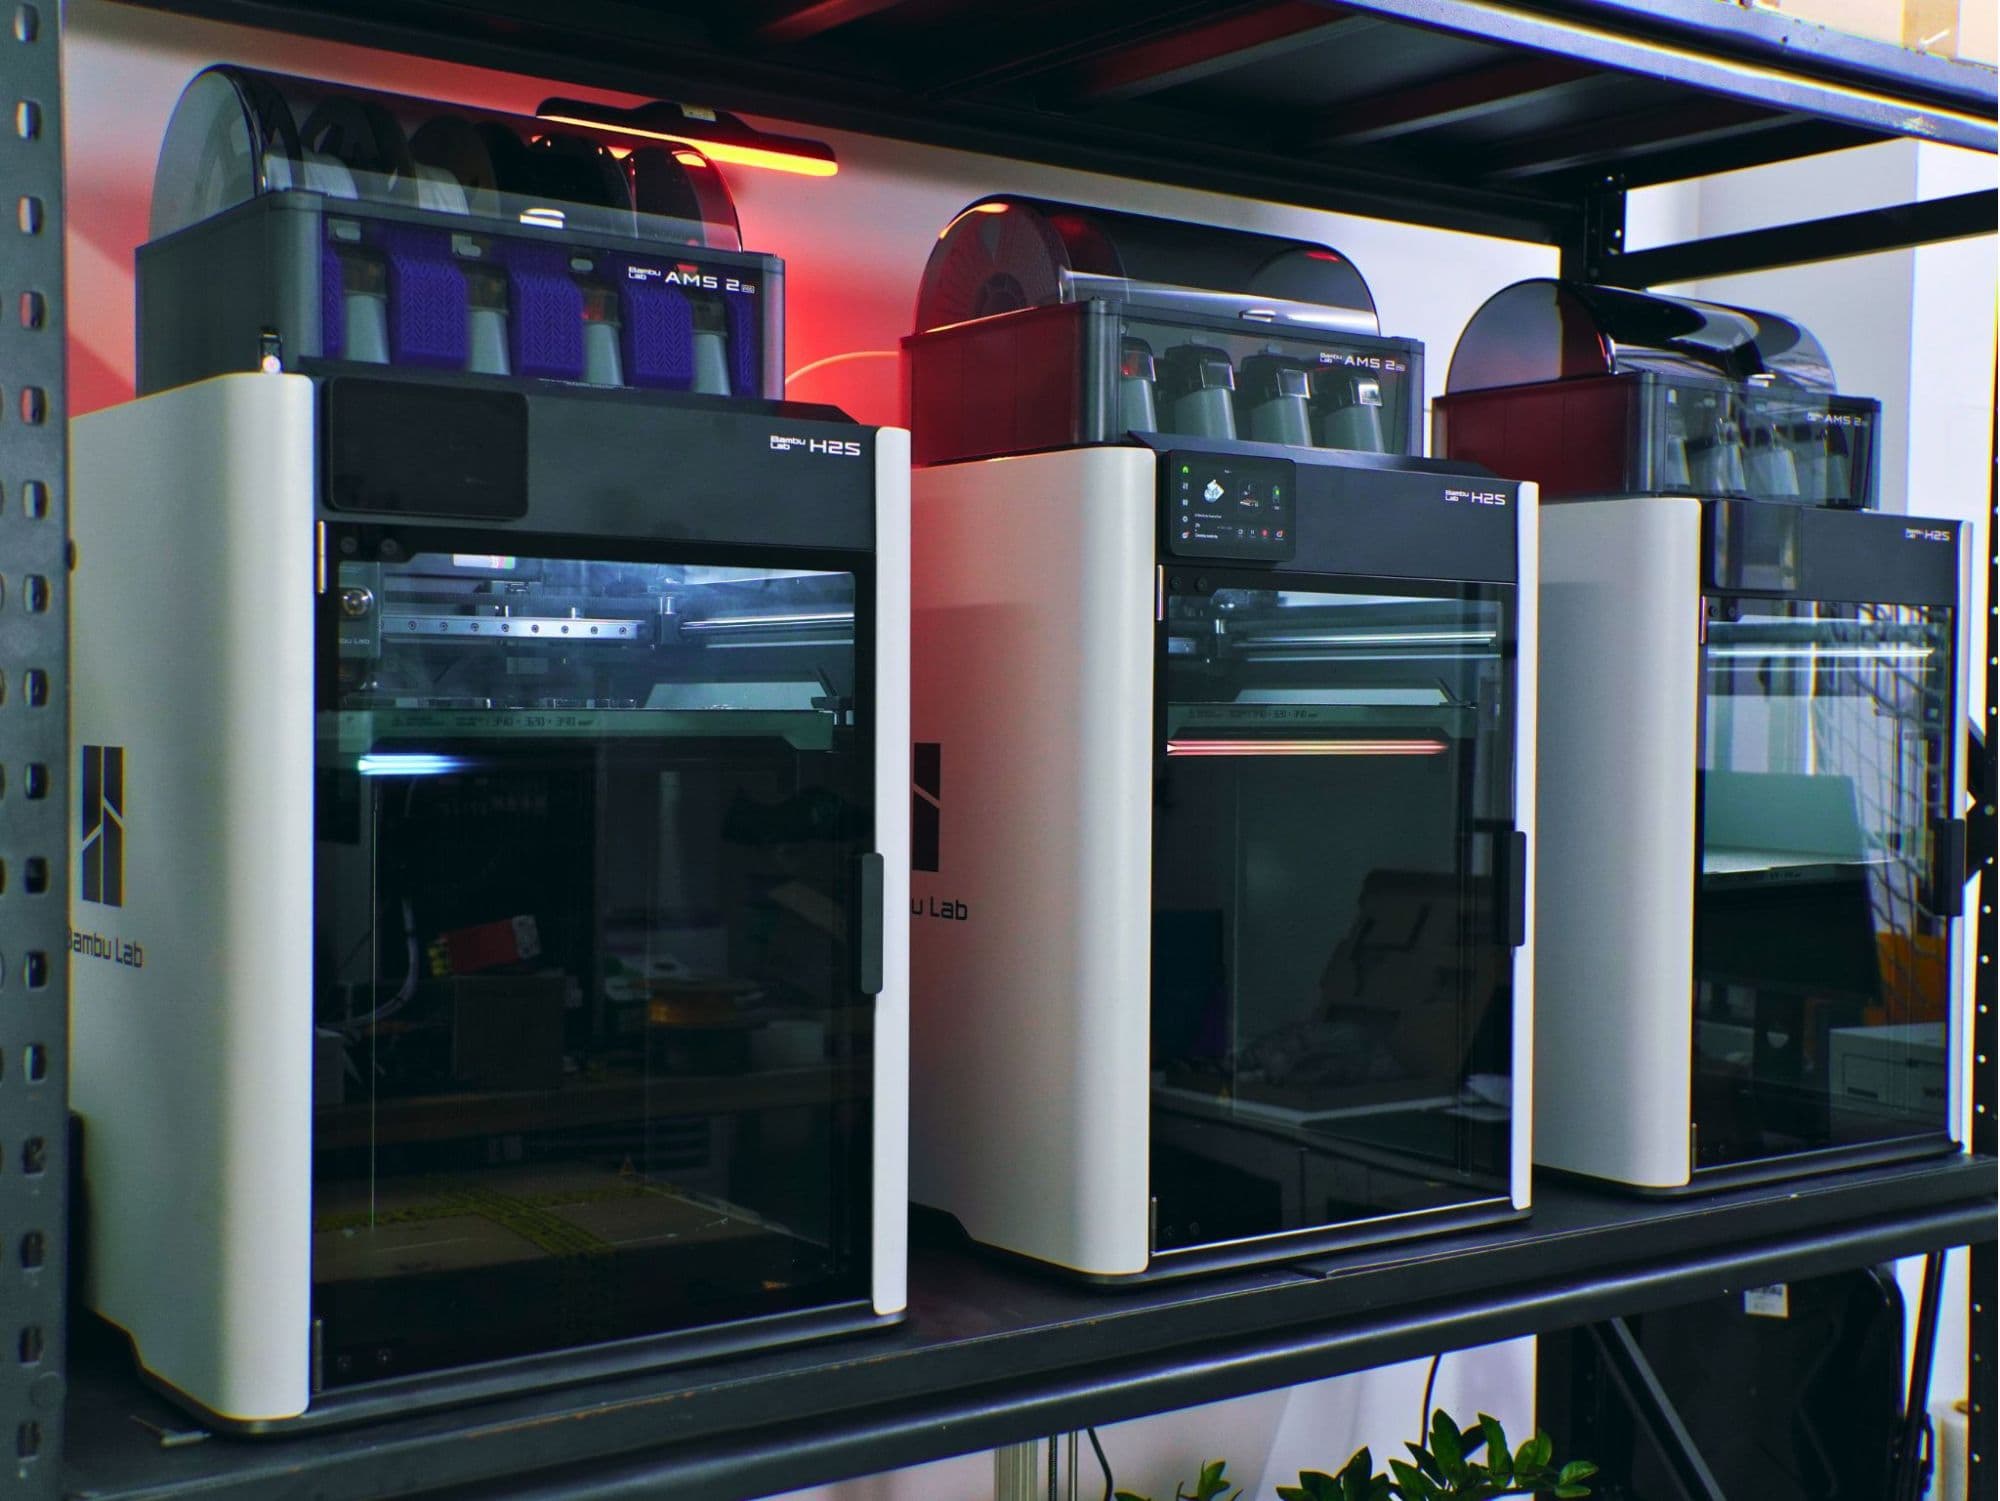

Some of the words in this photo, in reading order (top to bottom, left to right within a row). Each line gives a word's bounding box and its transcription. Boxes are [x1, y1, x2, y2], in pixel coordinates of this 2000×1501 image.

[628, 266, 661, 277] Bambu
[628, 273, 647, 281] Lab
[665, 272, 718, 289] AMS
[726, 278, 740, 292] 2
[1344, 355, 1380, 369] AMS
[1384, 359, 1395, 371] 2
[1824, 414, 1850, 425] AMS
[770, 435, 806, 445] Bambu
[770, 442, 790, 451] Lab
[810, 438, 860, 456] H2S
[1471, 491, 1506, 505] H2S
[1924, 528, 1950, 541] H2S
[930, 896, 968, 921] Lab
[115, 937, 143, 969] Lab
